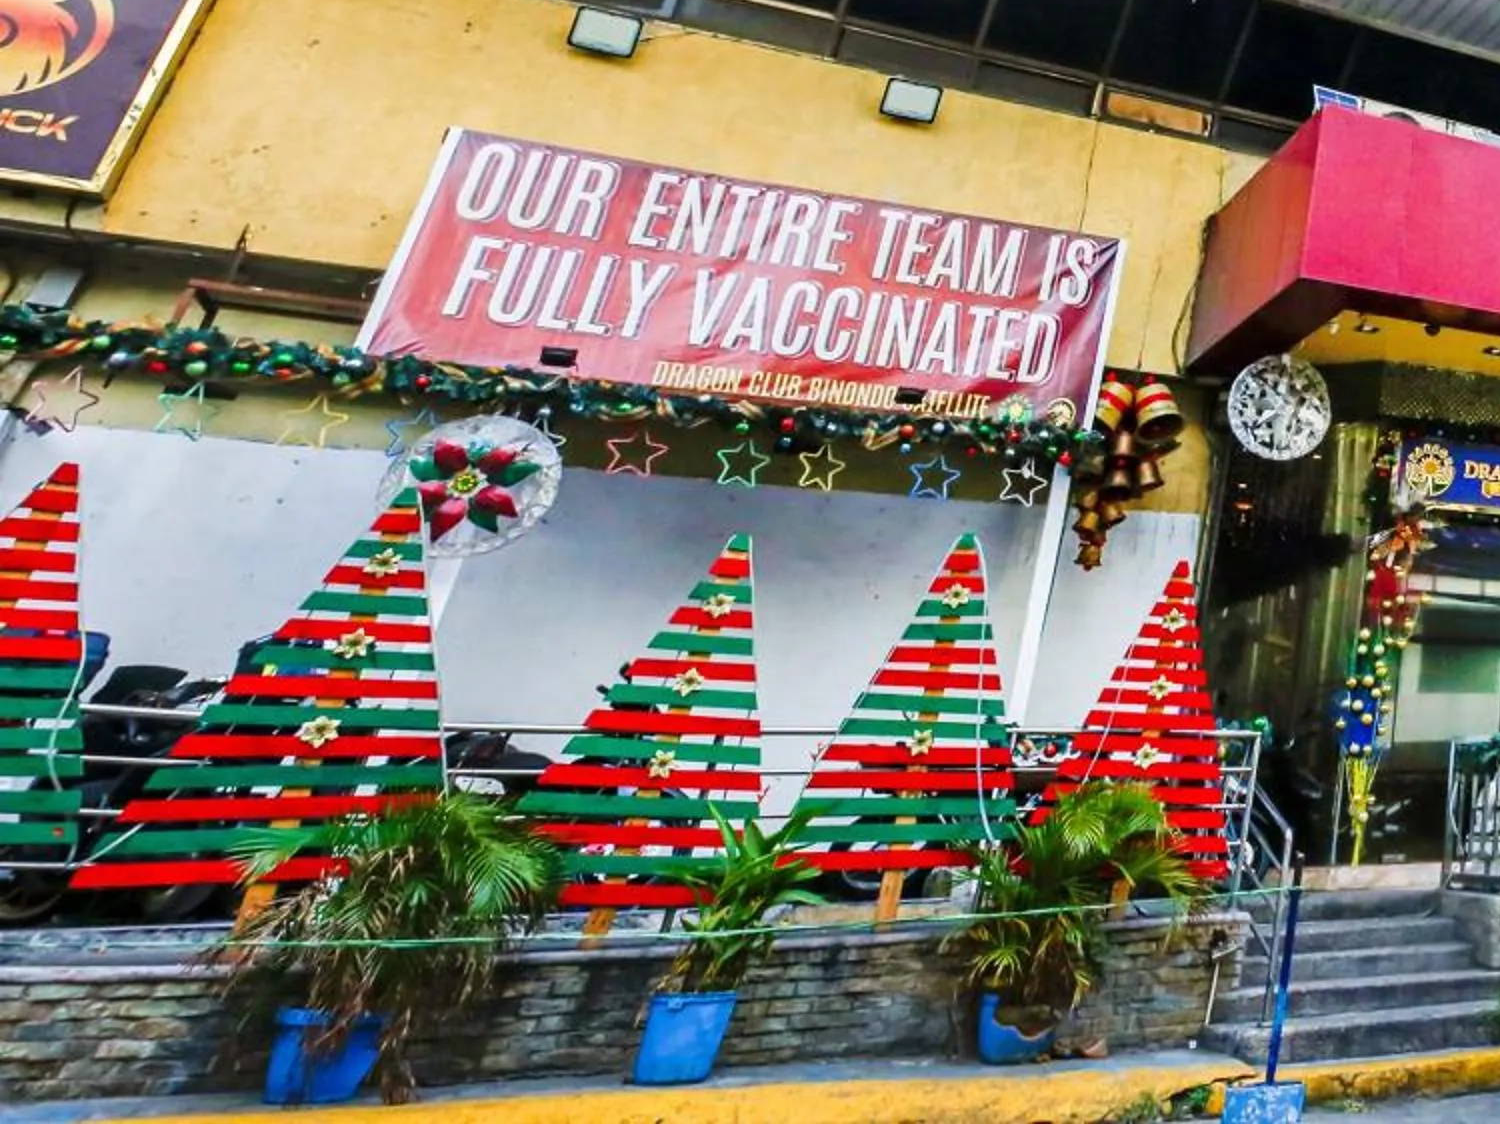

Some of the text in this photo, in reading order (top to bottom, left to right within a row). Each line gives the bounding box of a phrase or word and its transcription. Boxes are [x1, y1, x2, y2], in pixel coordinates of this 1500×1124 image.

[456, 142, 1097, 308] OUR ENTIRE TEAM IS
[442, 235, 1061, 385] FULLY VACCINATED
[651, 360, 991, 419] DRAGON CLUB BINONDO ATELLITE
